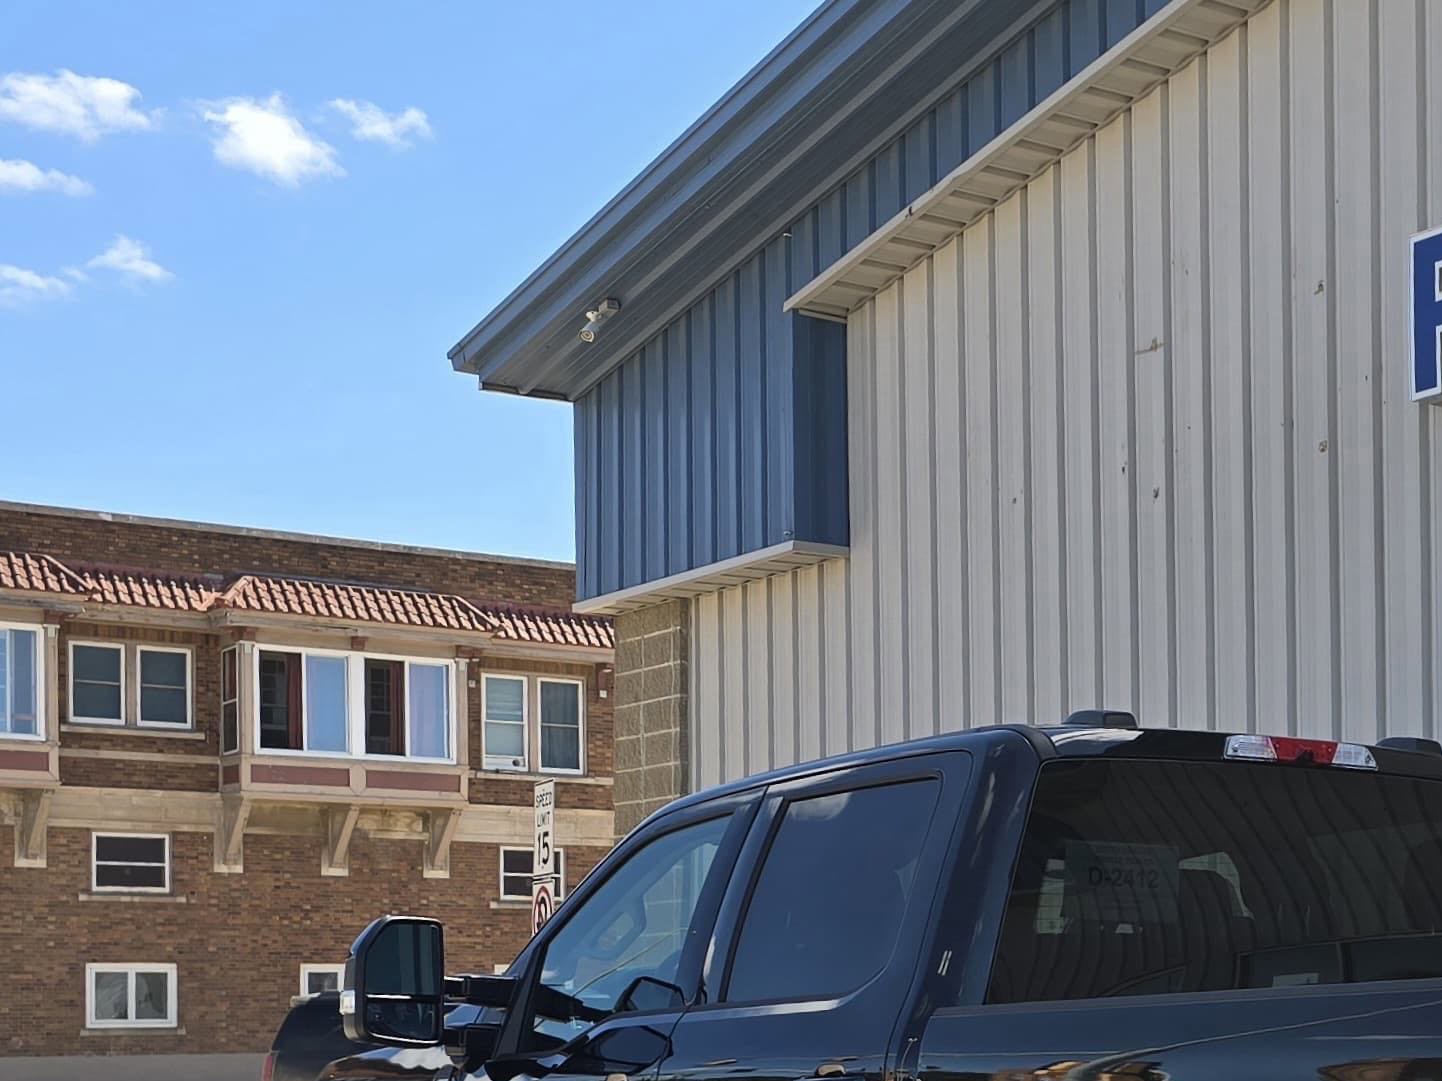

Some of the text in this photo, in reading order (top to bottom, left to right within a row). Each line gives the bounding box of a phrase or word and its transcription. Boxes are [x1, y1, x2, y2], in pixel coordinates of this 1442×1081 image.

[536, 791, 552, 808] SPEED
[537, 811, 551, 828] LIMIT
[537, 831, 550, 866] 15
